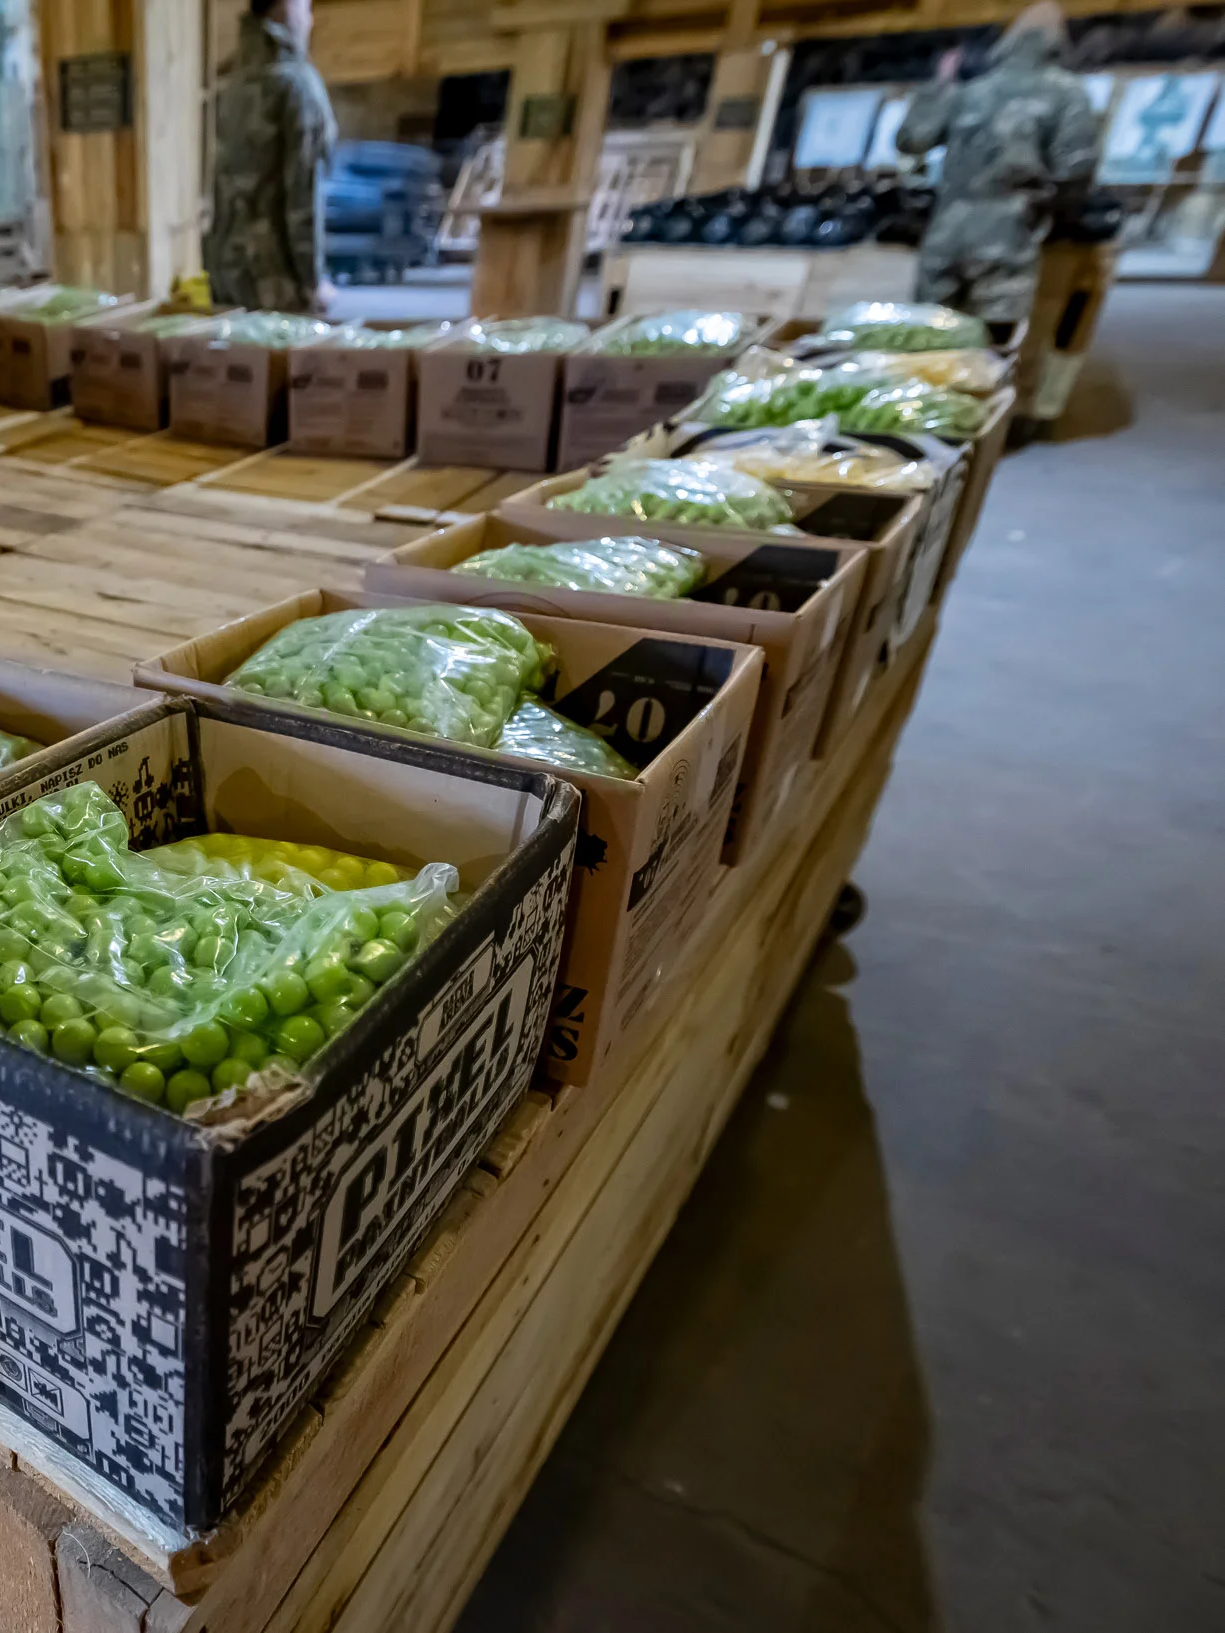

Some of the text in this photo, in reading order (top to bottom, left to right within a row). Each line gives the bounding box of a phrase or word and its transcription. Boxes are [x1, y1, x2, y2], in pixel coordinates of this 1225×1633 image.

[465, 358, 502, 382] 07
[586, 690, 666, 743] 20
[39, 763, 84, 793] NAPISZ
[87, 753, 103, 769] DO
[107, 741, 129, 759] NAS
[339, 987, 515, 1256] PIXEL
